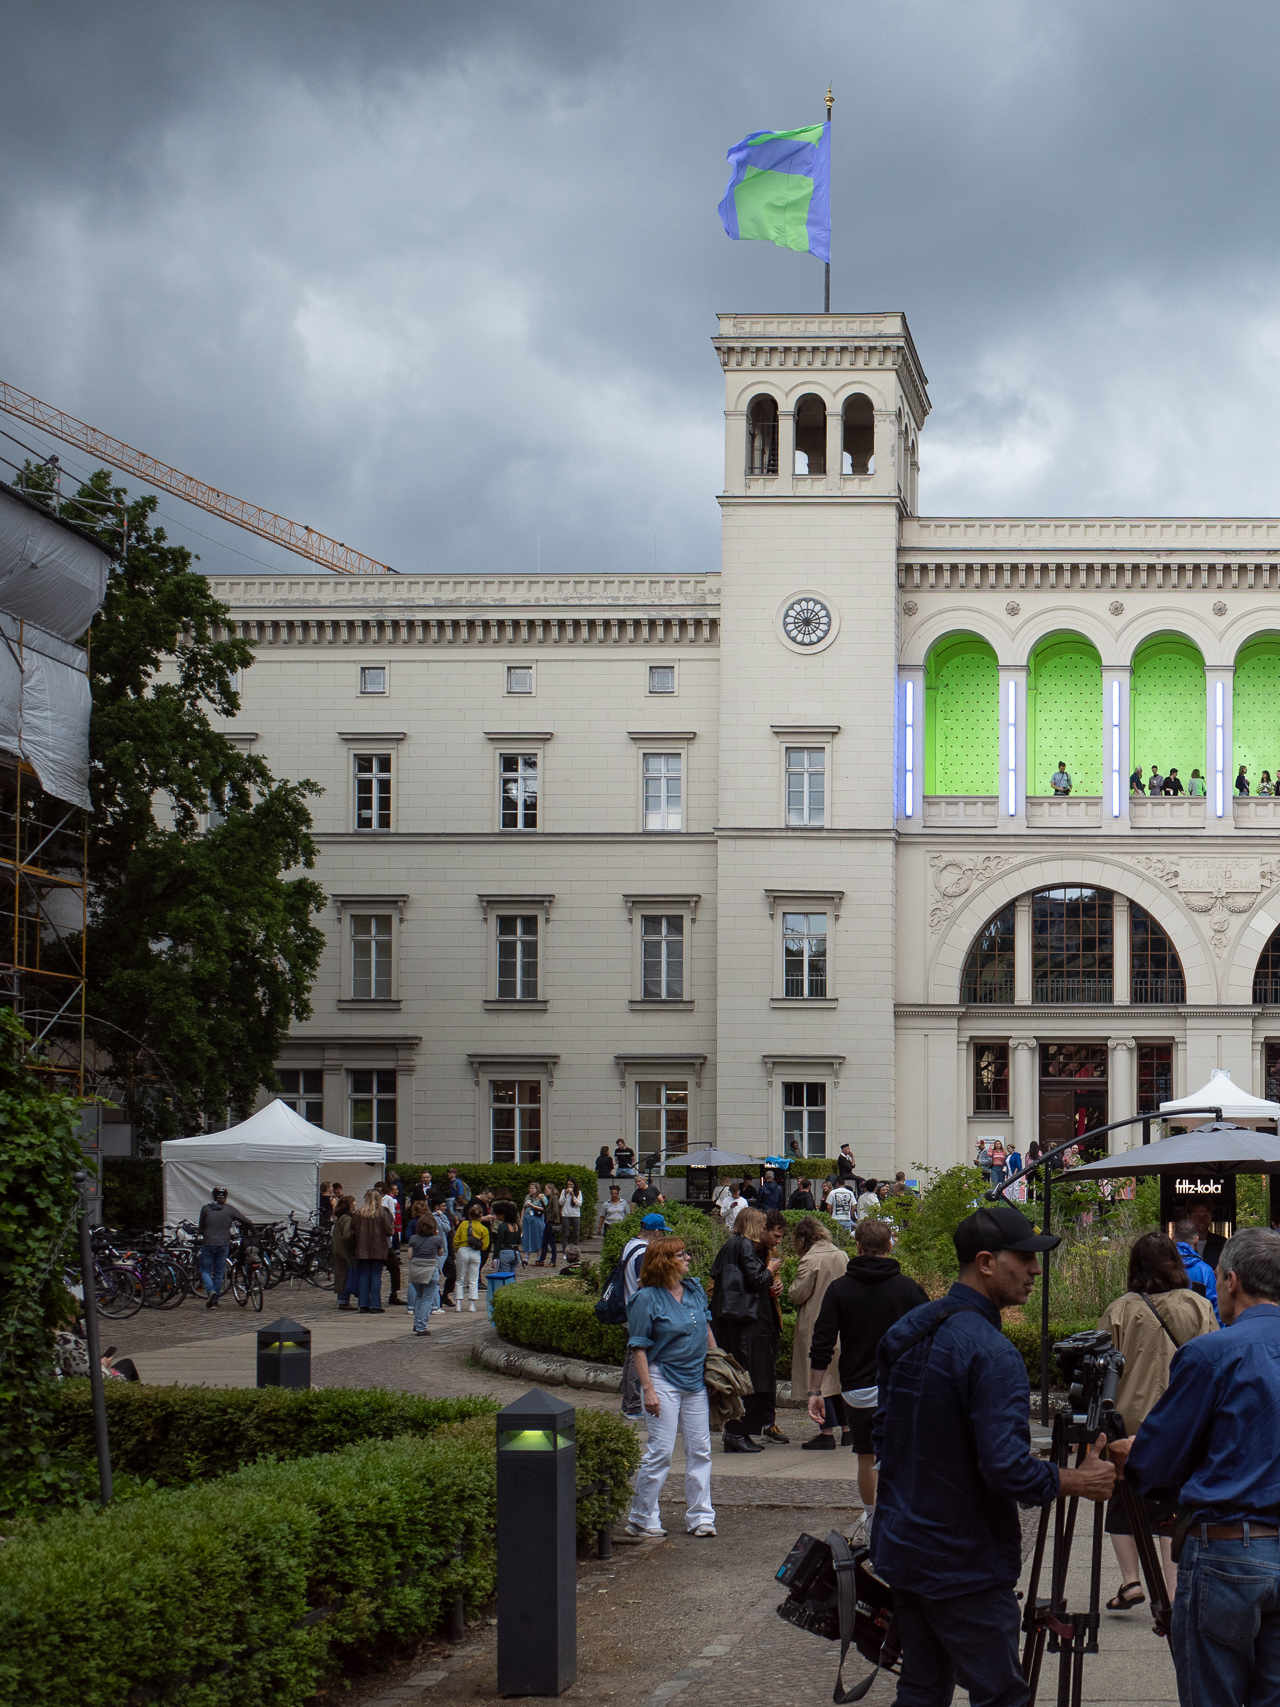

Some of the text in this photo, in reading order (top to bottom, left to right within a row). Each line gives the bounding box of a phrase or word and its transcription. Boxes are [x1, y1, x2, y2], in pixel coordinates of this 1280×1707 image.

[1187, 861, 1253, 869] VERKEHRS-
[1207, 870, 1232, 879] UND
[1181, 880, 1259, 888] BAUMUSEUM
[1175, 1179, 1222, 1194] fritz-kola
